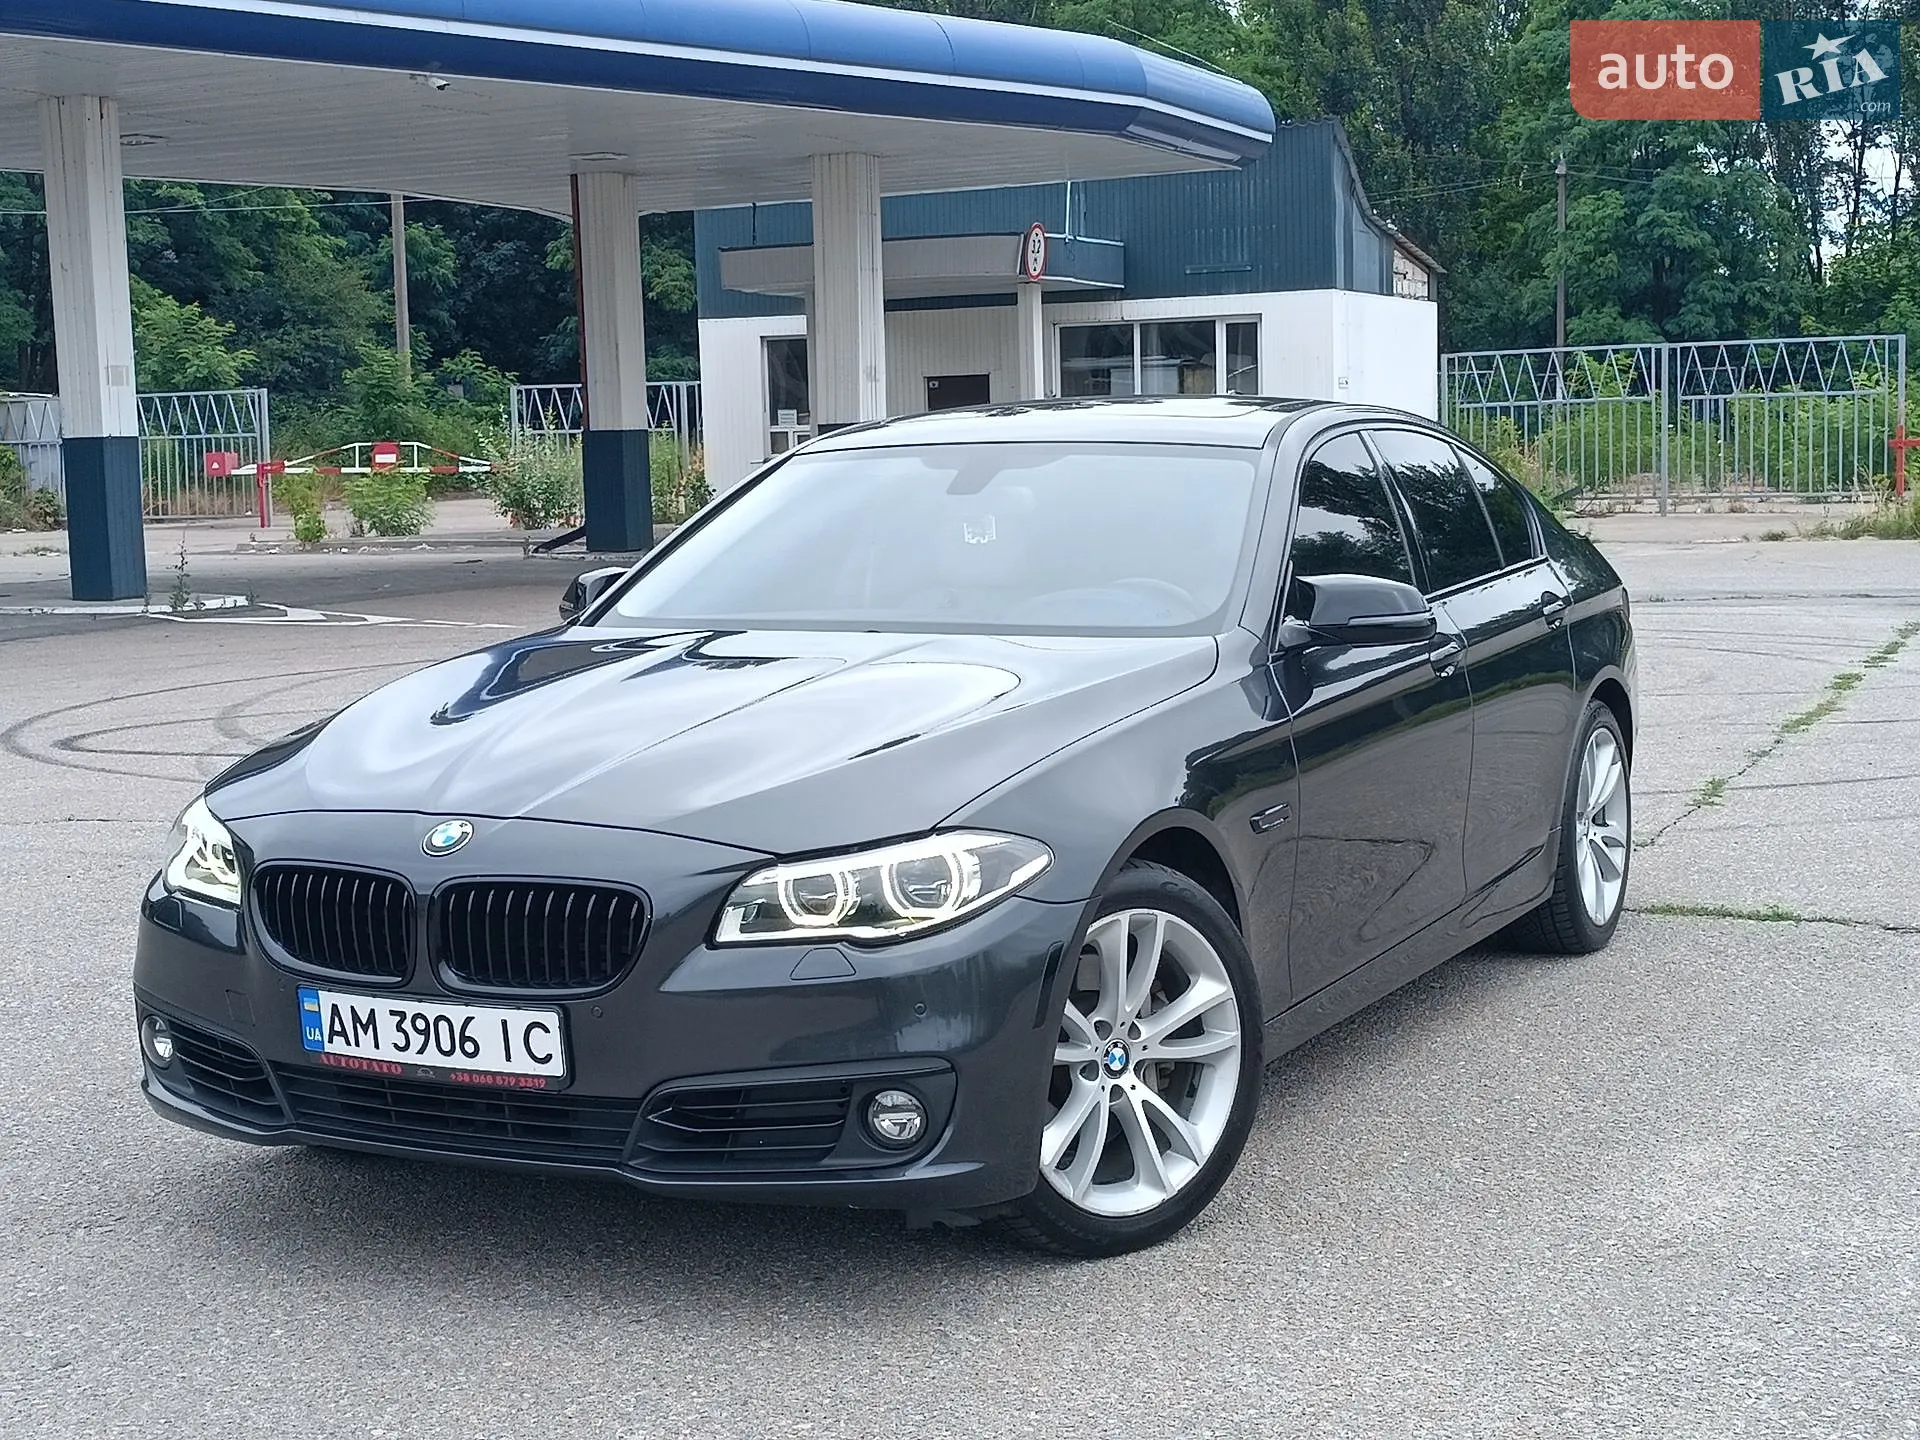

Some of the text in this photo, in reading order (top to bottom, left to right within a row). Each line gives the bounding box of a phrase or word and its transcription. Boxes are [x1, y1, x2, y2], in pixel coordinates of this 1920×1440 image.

[306, 1026, 322, 1042] UA
[327, 1003, 380, 1050] AM
[388, 1009, 480, 1058] 3906
